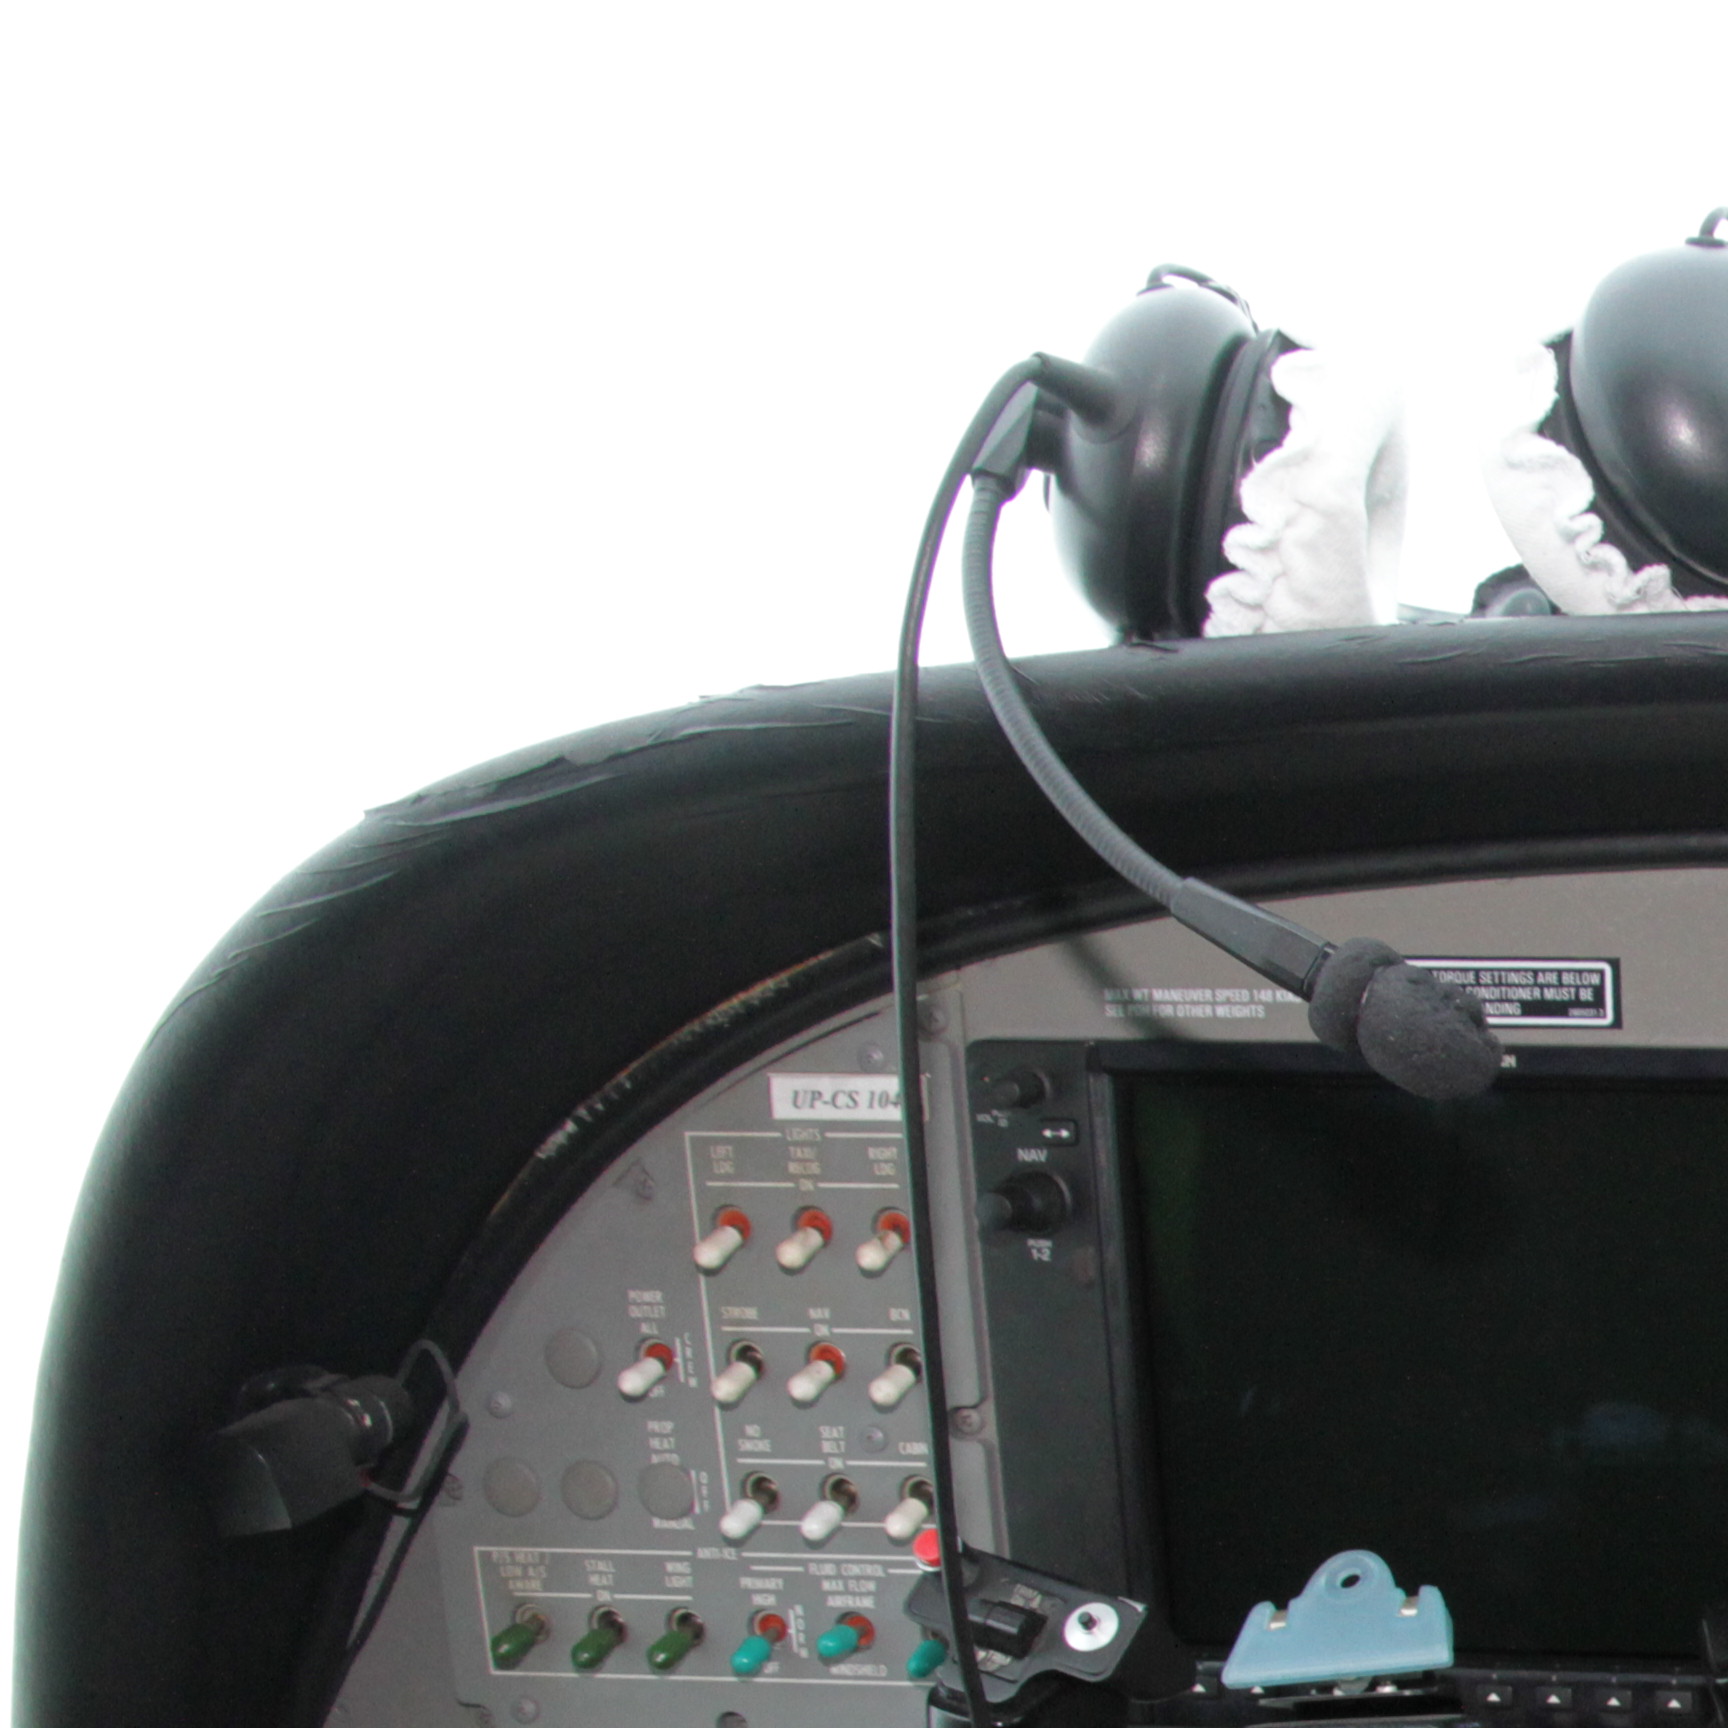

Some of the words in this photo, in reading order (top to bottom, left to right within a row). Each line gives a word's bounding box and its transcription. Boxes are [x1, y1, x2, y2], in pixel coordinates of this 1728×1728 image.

[1480, 972, 1534, 984] SETTINGS
[1537, 972, 1559, 984] ARE
[1562, 973, 1600, 985] BELOW
[1466, 987, 1541, 999] CONDITIONER
[1544, 988, 1575, 1000] MUST
[1579, 988, 1593, 1000] BE
[793, 1089, 859, 1110] UP-CS
[867, 1089, 903, 1110] 104
